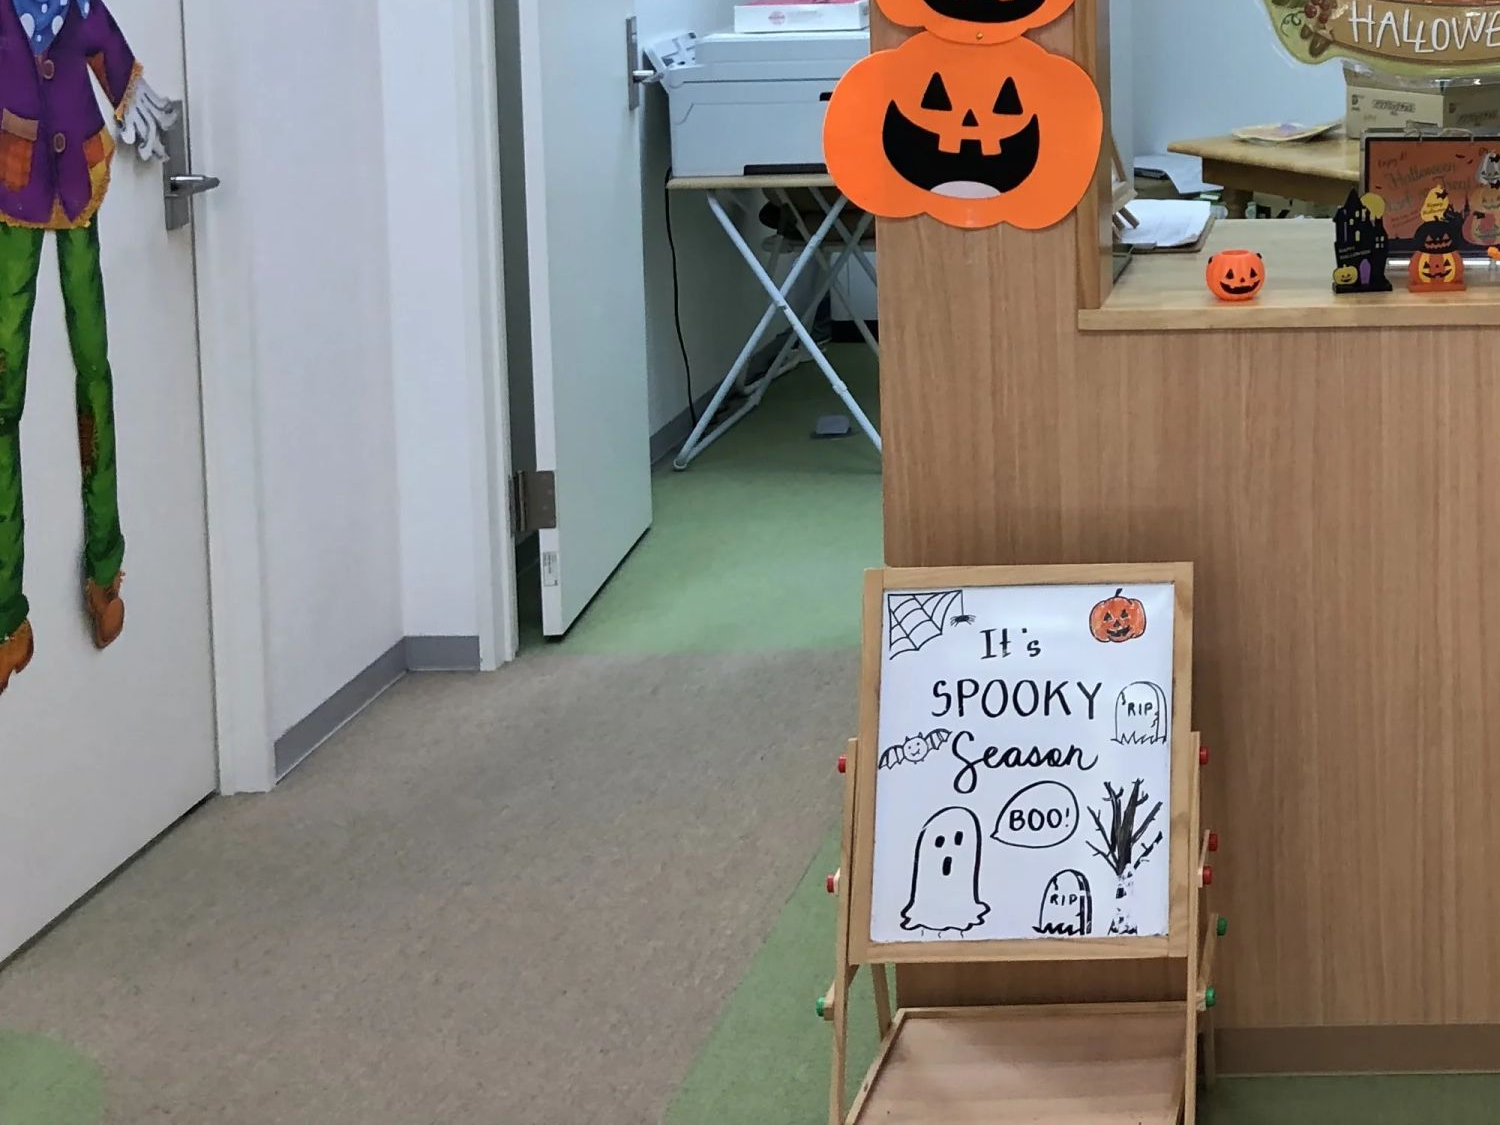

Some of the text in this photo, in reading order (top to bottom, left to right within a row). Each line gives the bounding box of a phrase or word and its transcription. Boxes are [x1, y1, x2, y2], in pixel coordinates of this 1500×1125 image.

[980, 627, 1041, 659] It's
[931, 678, 1103, 720] SPOOKY
[1126, 701, 1154, 716] RIP
[950, 730, 1099, 794] Season
[1008, 807, 1071, 832] BOO!
[1049, 893, 1078, 906] RIP
